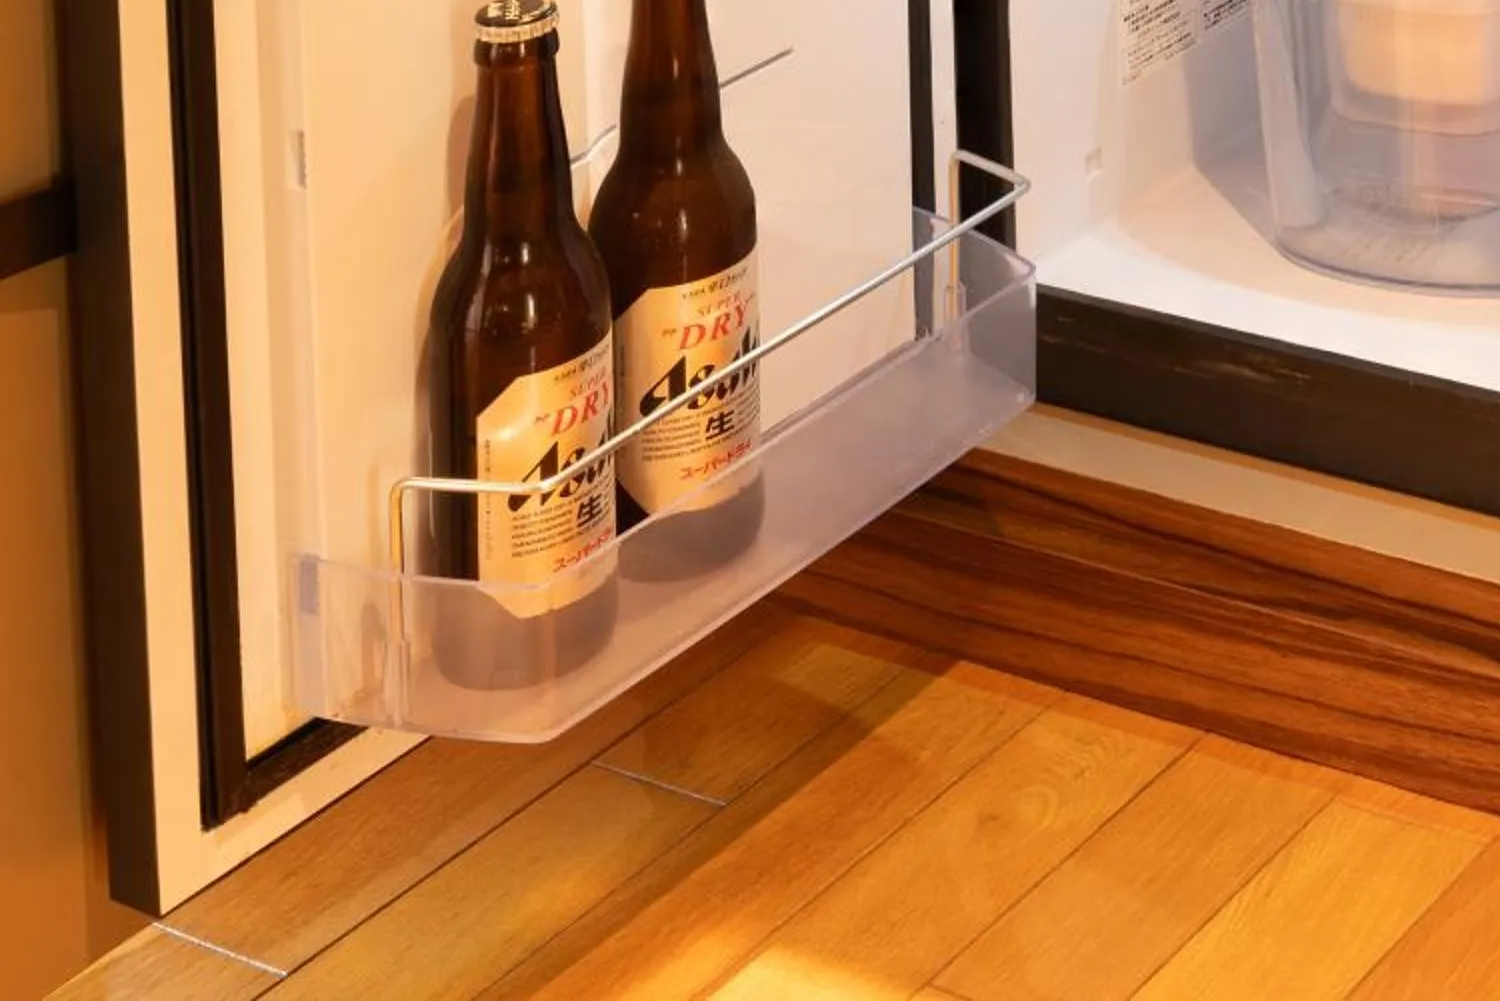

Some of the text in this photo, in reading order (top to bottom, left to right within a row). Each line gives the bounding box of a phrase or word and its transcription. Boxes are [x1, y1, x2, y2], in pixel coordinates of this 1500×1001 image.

[679, 291, 755, 351] DRY
[705, 410, 735, 441] 生
[576, 493, 603, 528] 生
